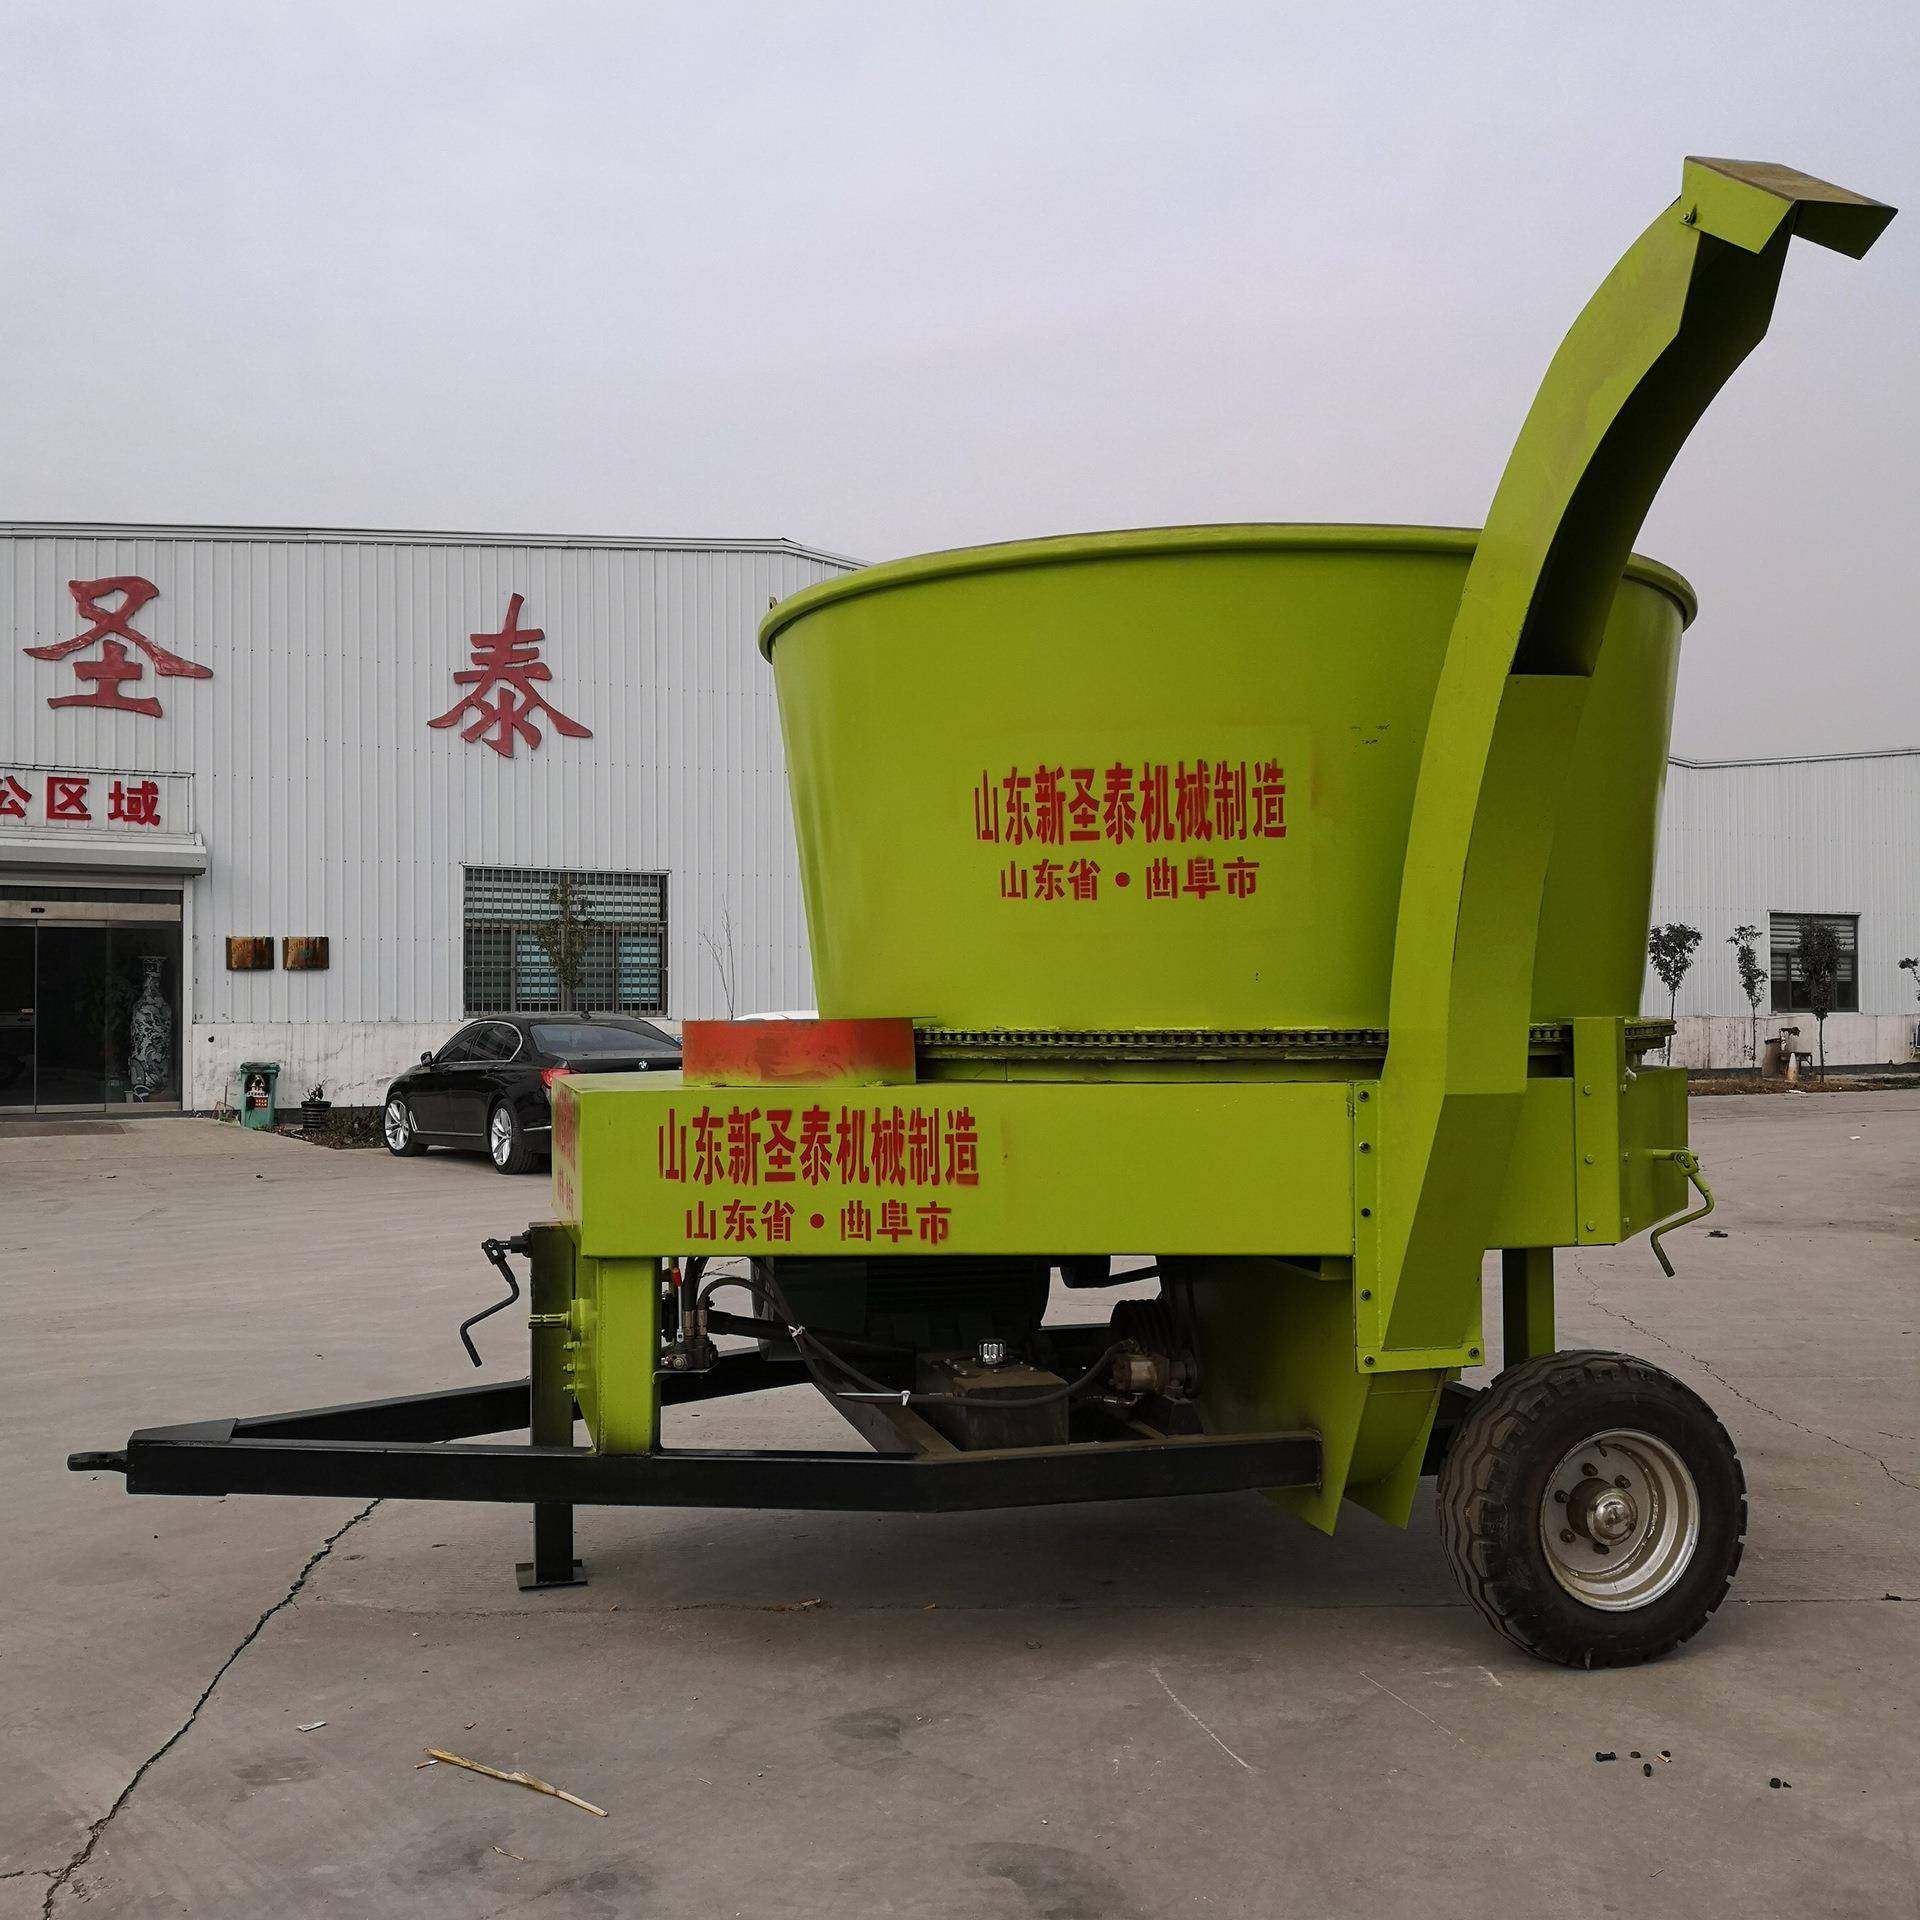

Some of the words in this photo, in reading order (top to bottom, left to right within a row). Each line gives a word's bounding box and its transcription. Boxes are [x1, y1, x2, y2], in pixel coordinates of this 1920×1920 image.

[973, 758, 1288, 845] 山东新圣泰机械制造
[658, 1105, 980, 1186] 山东新圣泰机械制造
